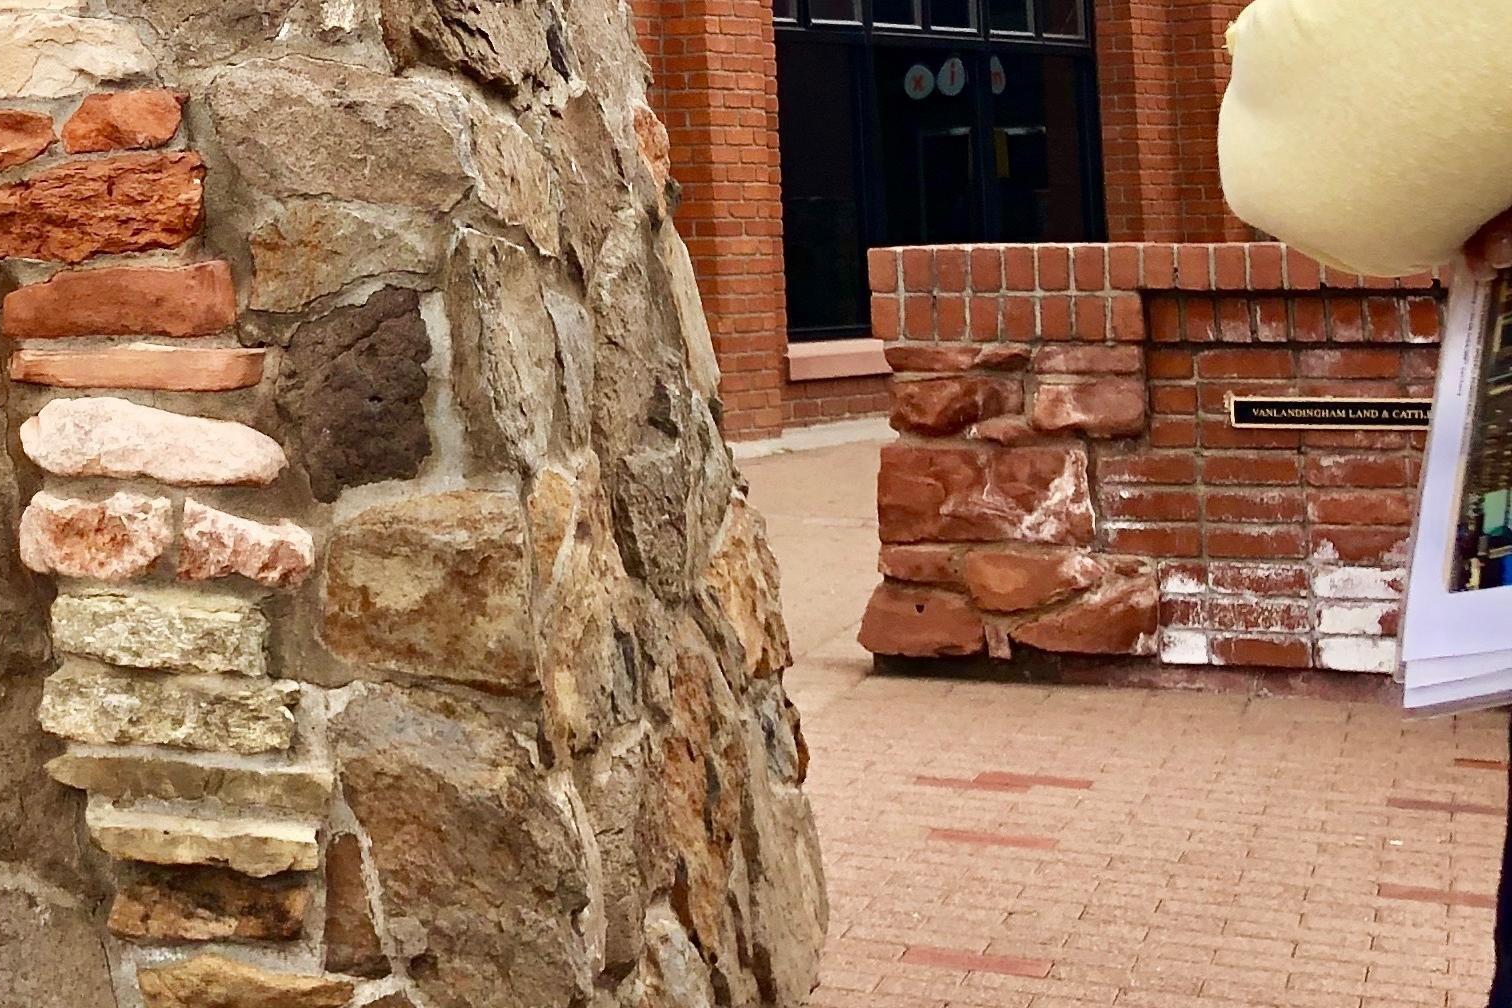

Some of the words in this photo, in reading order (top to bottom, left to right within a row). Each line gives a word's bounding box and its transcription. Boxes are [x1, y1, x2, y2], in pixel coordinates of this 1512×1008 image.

[1252, 408, 1346, 419] VANLANDINGHAM
[1348, 409, 1379, 419] LAND
[1381, 409, 1390, 419] &
